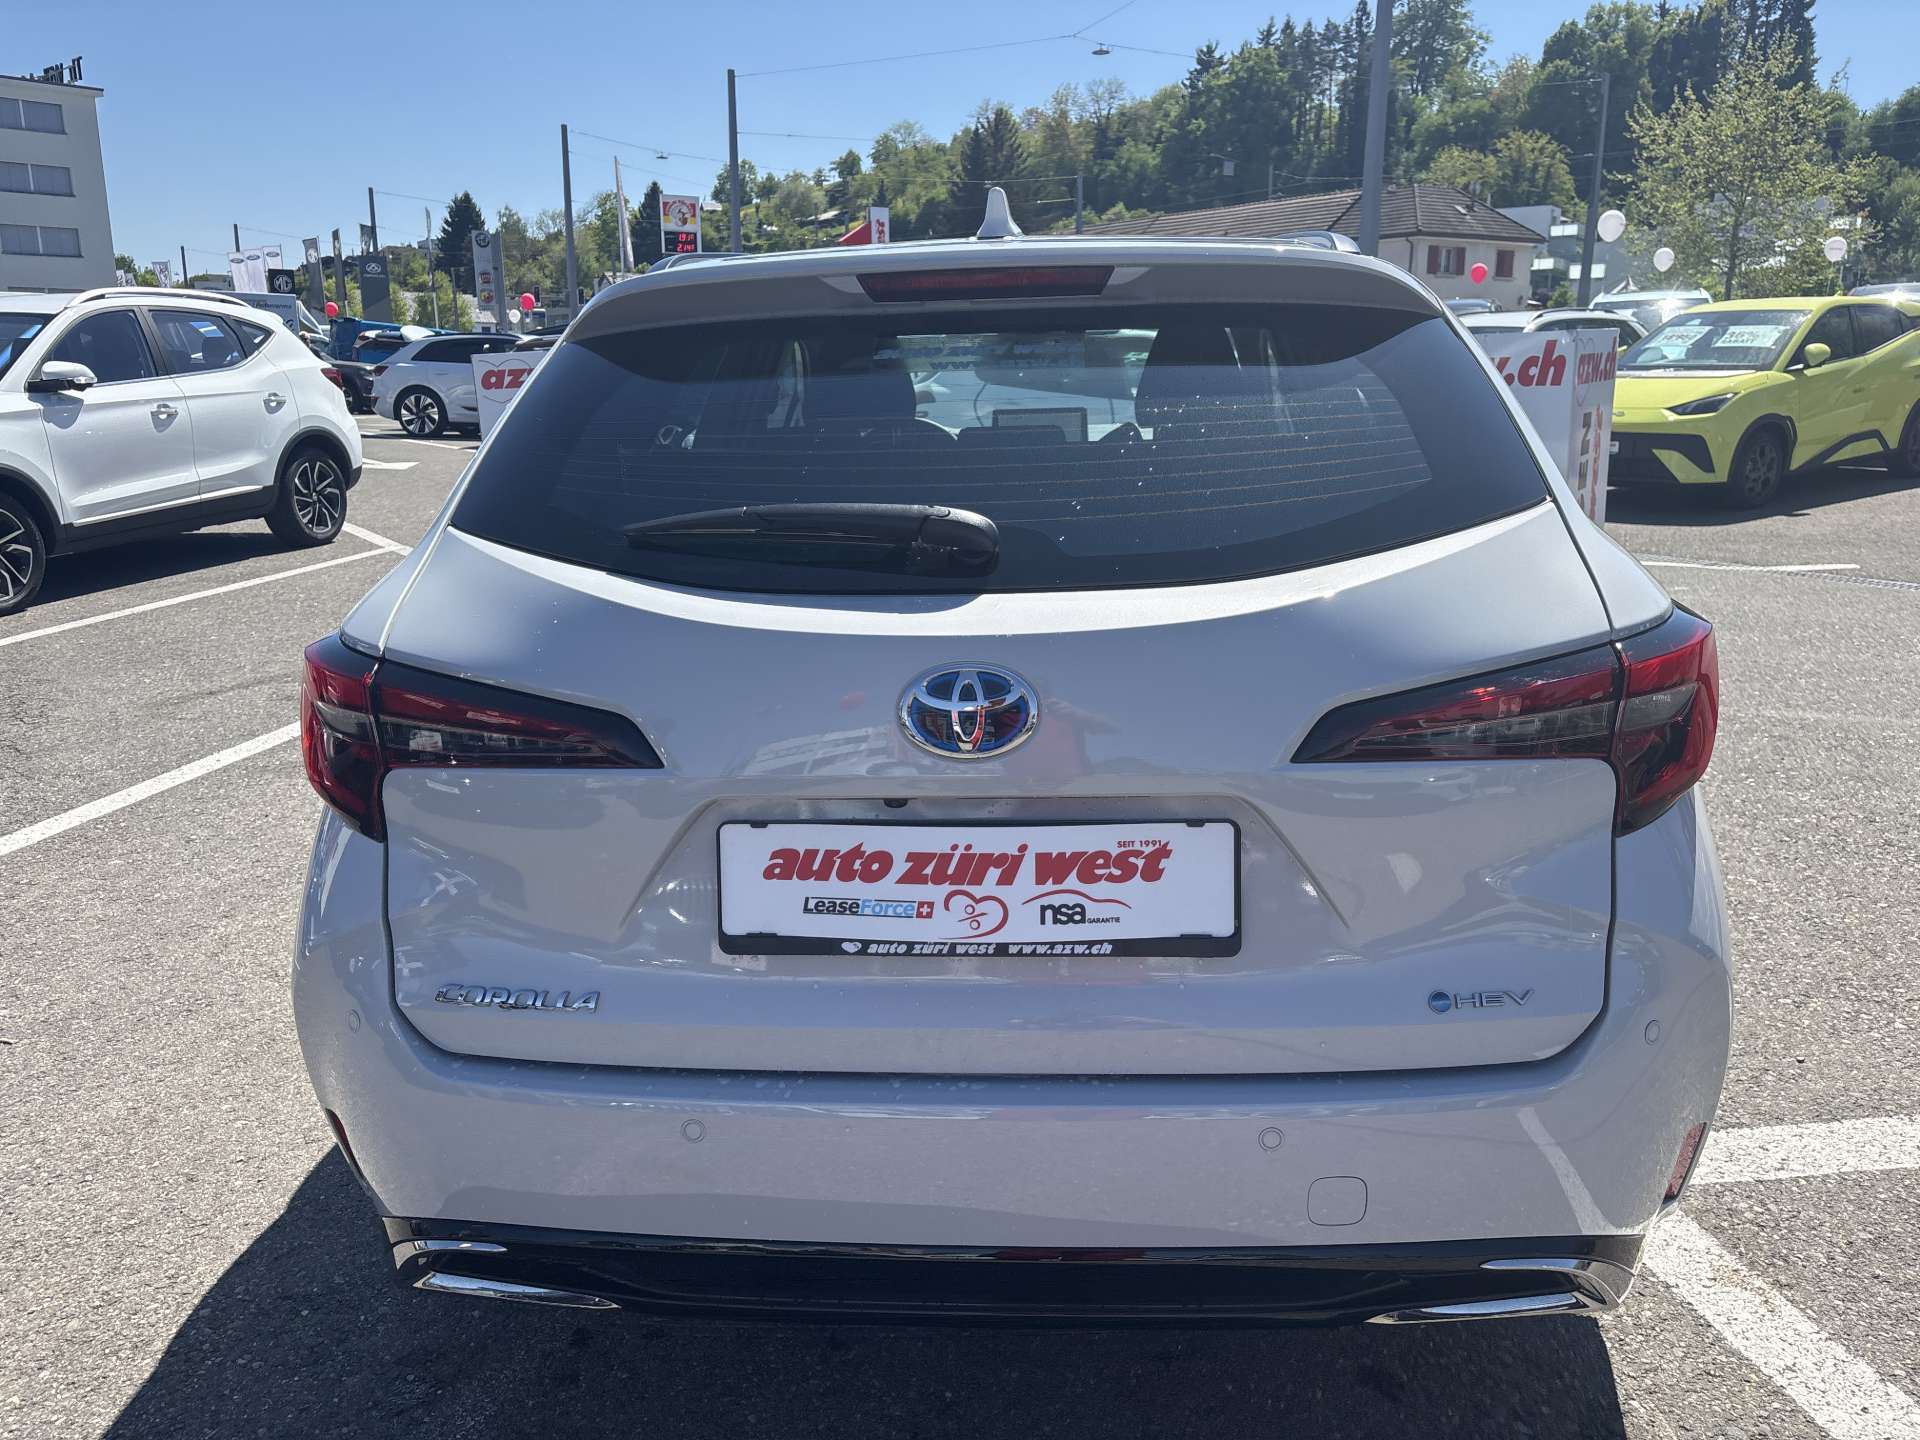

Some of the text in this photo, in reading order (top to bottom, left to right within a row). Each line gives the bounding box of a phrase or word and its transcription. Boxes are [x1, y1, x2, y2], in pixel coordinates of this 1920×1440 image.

[275, 276, 292, 291] MG
[1577, 336, 1617, 386] azw.ch
[481, 367, 535, 390] az
[1116, 838, 1163, 848] SEIT 1991
[762, 839, 1174, 887] auto züri west
[802, 896, 915, 917] LeaseForce
[1039, 902, 1087, 926] nsa
[1086, 916, 1121, 925] GARANTIE
[867, 940, 1113, 957] auto züri west www.azw.ch
[434, 983, 601, 1013] COROLLA
[1454, 988, 1535, 1010] HEV
